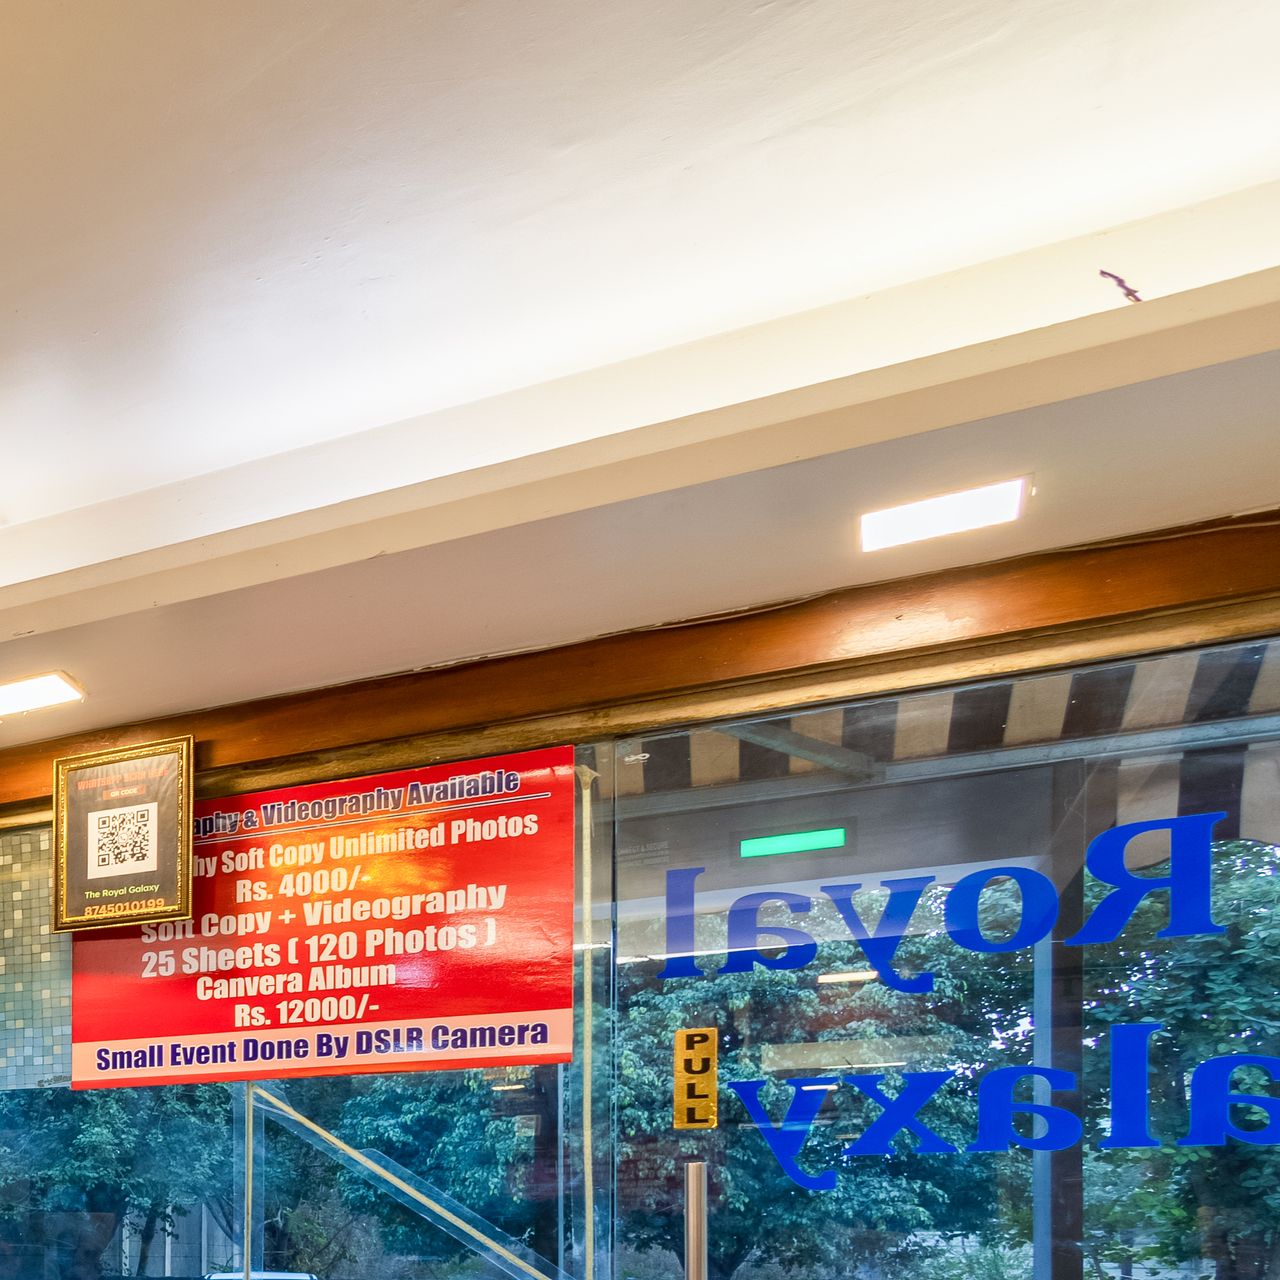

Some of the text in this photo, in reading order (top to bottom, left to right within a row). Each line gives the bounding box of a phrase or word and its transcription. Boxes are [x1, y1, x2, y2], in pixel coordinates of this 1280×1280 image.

[110, 790, 120, 798] QR
[193, 770, 520, 838] aphy & Videography Available
[222, 847, 264, 873] Soft
[269, 842, 325, 868] Copy
[330, 824, 446, 860] Unlimited
[450, 814, 539, 846] Photos
[84, 898, 165, 917] 8745010199
[85, 884, 160, 899] The Royal Galaxy
[201, 913, 272, 937] Copy
[278, 909, 297, 926] +
[301, 883, 507, 927] Videography
[236, 879, 273, 904] Rs.
[141, 950, 176, 979] 25
[181, 942, 281, 976] Sheets
[305, 932, 357, 963] 120
[364, 923, 477, 960] Photos
[197, 962, 397, 1001] Canvera Album
[234, 995, 380, 1028] Rs. 12000/-
[96, 1020, 549, 1071] Small Event Done By DSLR Camera
[683, 1033, 711, 1124] PULL
